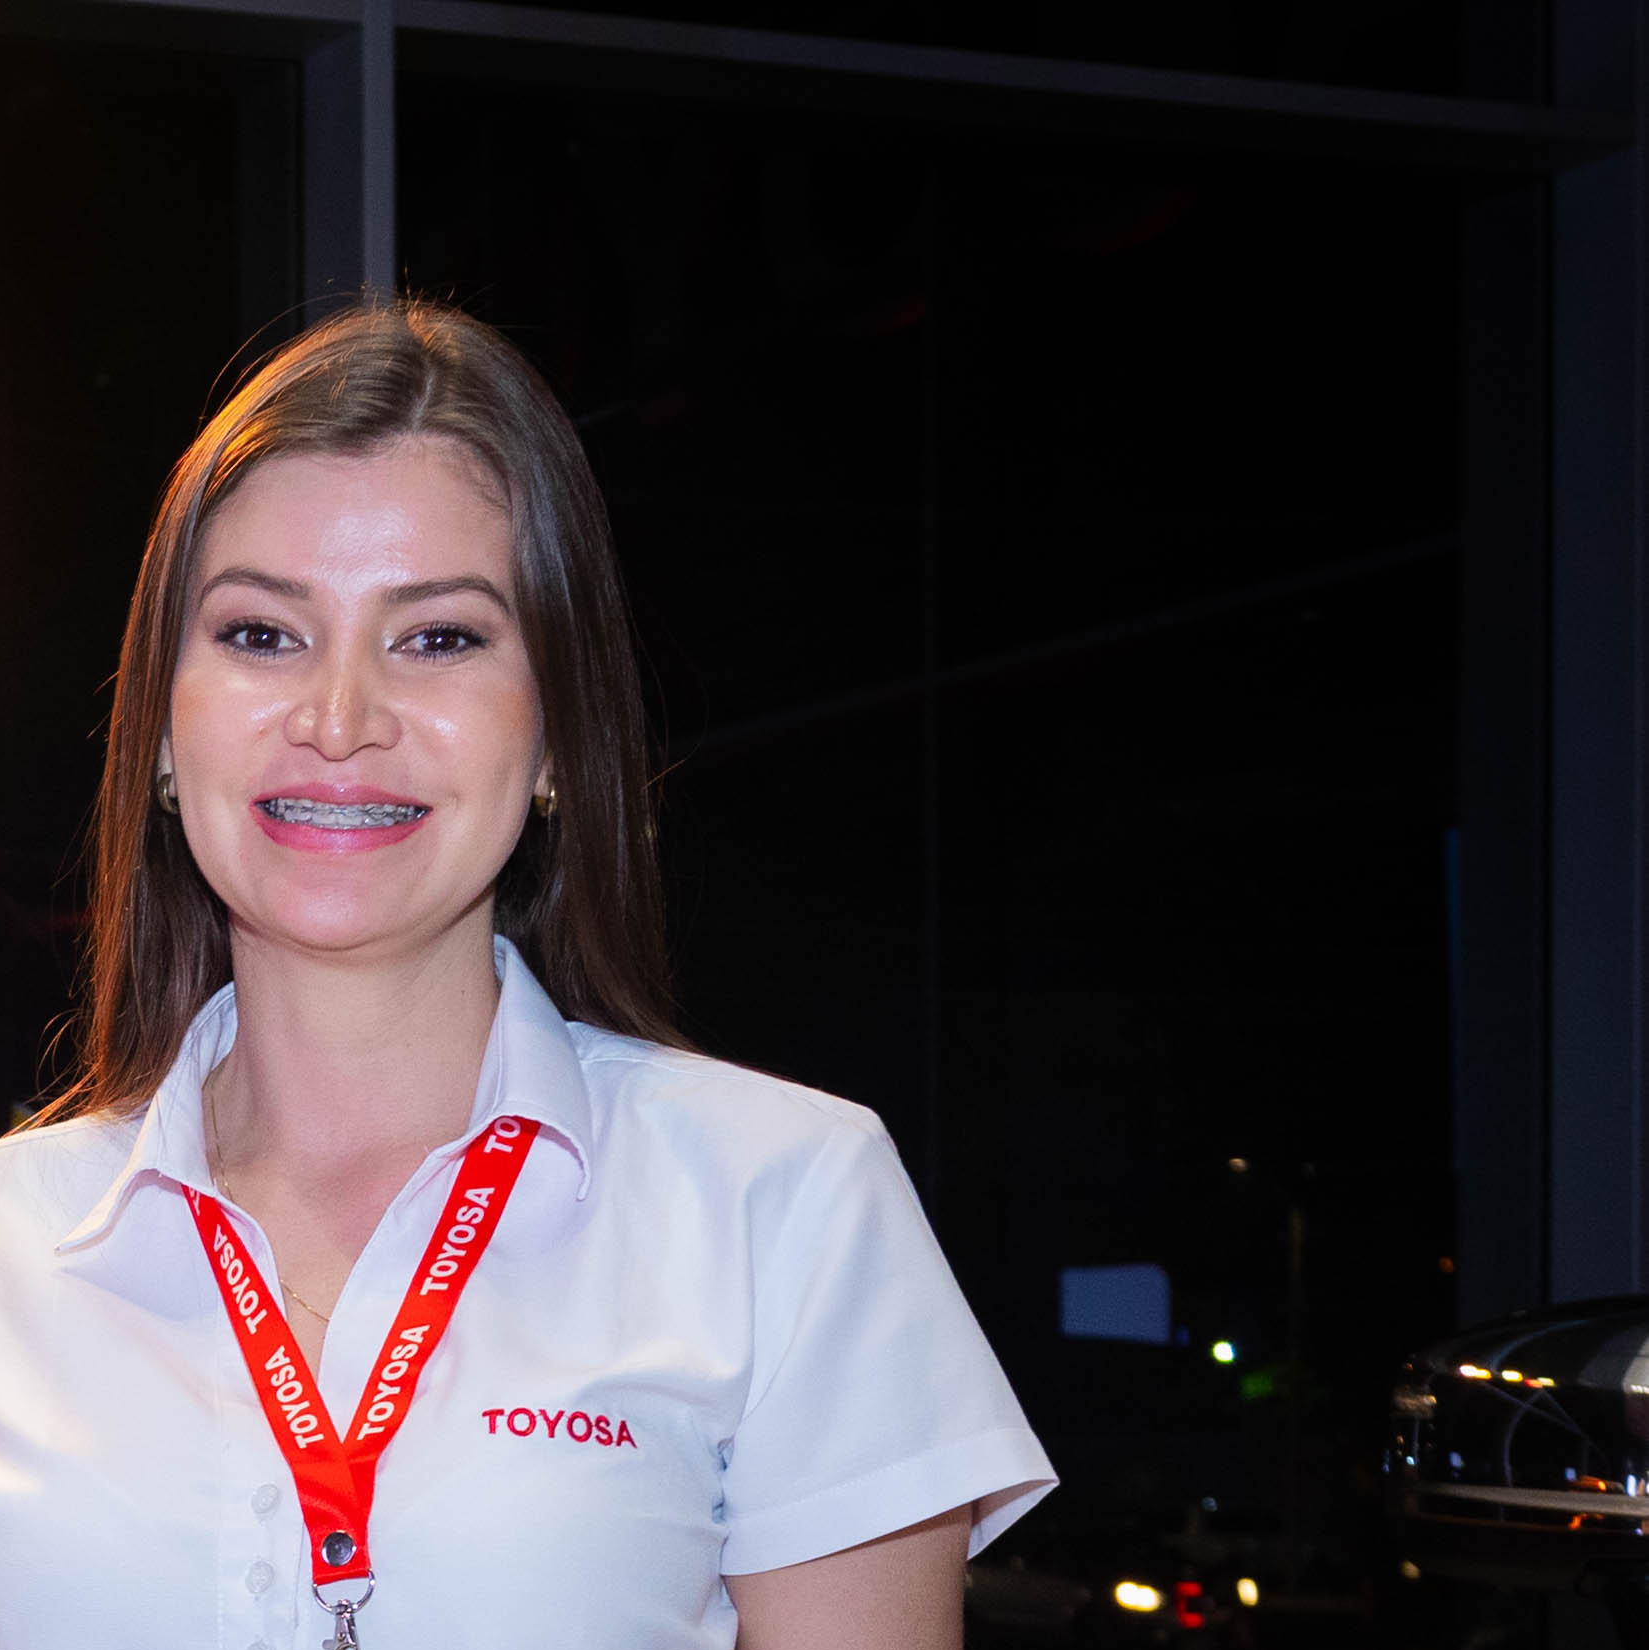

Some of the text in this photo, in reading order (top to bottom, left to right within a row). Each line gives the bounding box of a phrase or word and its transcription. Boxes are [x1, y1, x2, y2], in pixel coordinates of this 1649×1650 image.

[213, 1223, 268, 1335] TOYOSA
[420, 1186, 496, 1297] TOYOSA
[264, 1345, 325, 1449] TOYOSA
[357, 1324, 431, 1441] TOYOSA
[482, 1407, 638, 1449] TOYOSA
